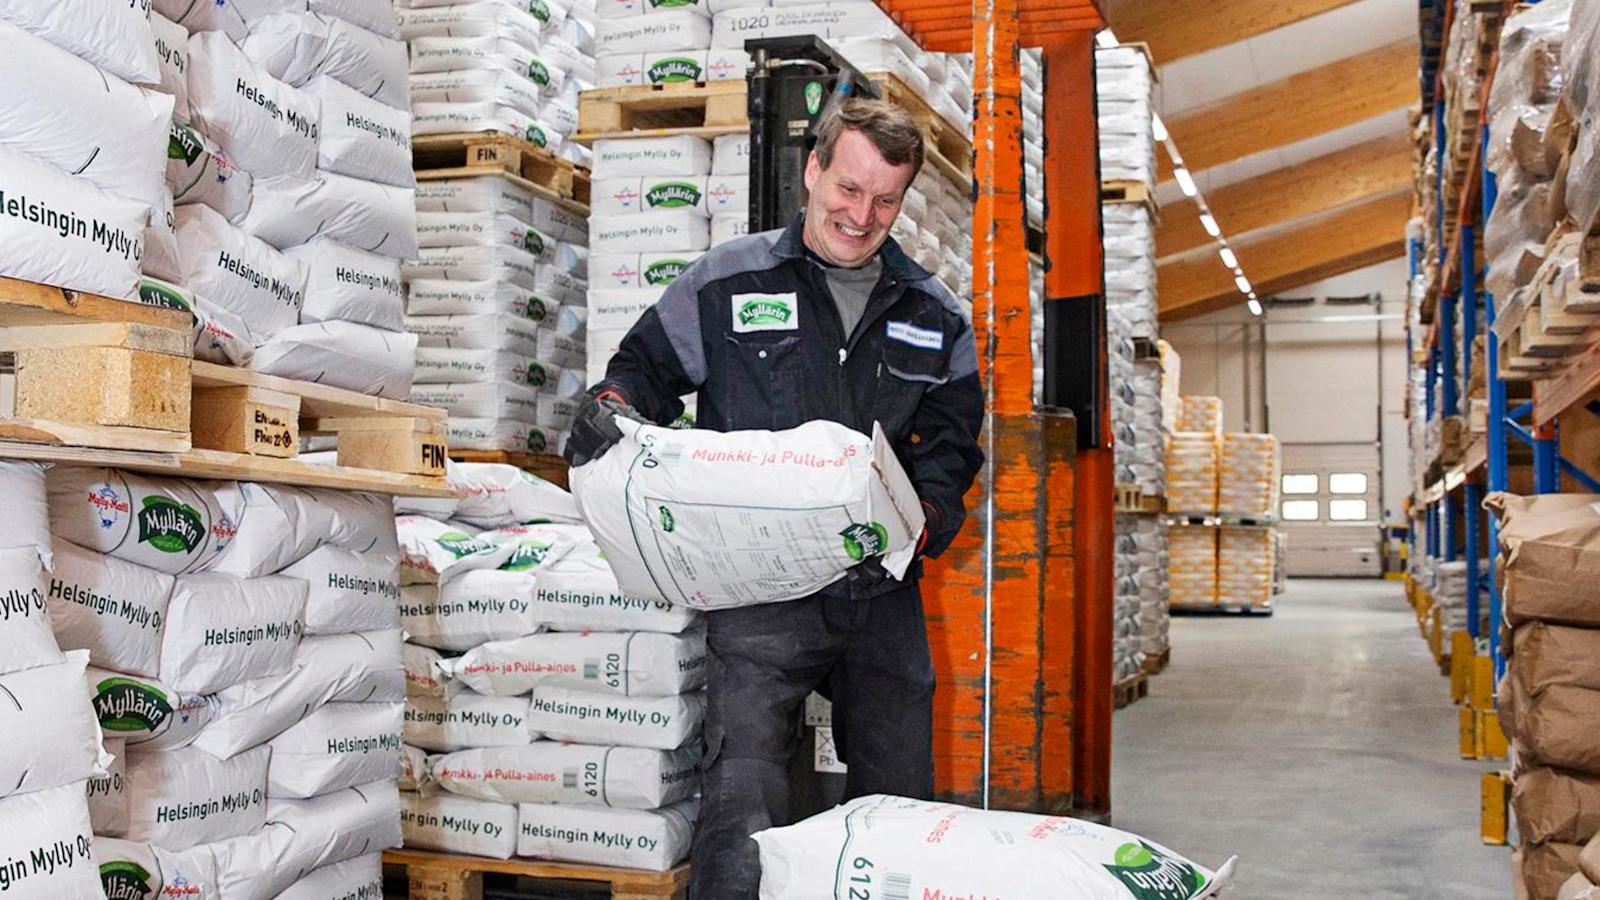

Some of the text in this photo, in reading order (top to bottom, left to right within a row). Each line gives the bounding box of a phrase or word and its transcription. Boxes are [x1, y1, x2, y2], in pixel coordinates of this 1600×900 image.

[730, 15, 770, 32] 1020
[653, 62, 696, 79] Myllärin
[346, 111, 390, 139] Helsingin
[477, 148, 498, 161] FIN
[651, 186, 695, 203] Myllärin
[92, 219, 131, 260] Mylly
[218, 250, 269, 291] Helsingin
[271, 278, 294, 305] Mylly
[336, 266, 381, 290] Helsingin
[742, 302, 787, 320] Myllärin
[421, 443, 445, 469] FIN
[691, 448, 758, 463] Munkki-
[761, 451, 776, 466] ja
[146, 508, 198, 546] Myllärin
[327, 573, 377, 596] Helsingin
[0, 589, 29, 620] ylly
[50, 578, 118, 615] Helsingin
[120, 602, 151, 629] Mylly
[400, 598, 529, 618] Helsingin Mylly Oy
[537, 588, 604, 608] Helsingin
[609, 594, 650, 612] Mylly
[204, 626, 264, 646] Helsingin
[266, 622, 291, 642] Mylly
[502, 664, 513, 675] ja
[514, 660, 577, 674] Pulla-aines
[606, 652, 620, 688] 6120
[99, 689, 164, 726] Myllärin
[403, 708, 522, 728] elsingin Mylly Oy
[533, 698, 671, 727] Helsingin Mylly Oy
[327, 733, 400, 754] Helsingin Mylly
[494, 768, 557, 782] Pulla-aines
[584, 761, 598, 797] 6120
[156, 795, 219, 824] Helsingin
[221, 791, 251, 813] Mylly
[442, 815, 480, 835] Mylly
[483, 822, 503, 838] Oy
[521, 822, 658, 852] Helsingin Mylly Oy
[30, 840, 74, 875] Mylly
[76, 834, 91, 860] Oy
